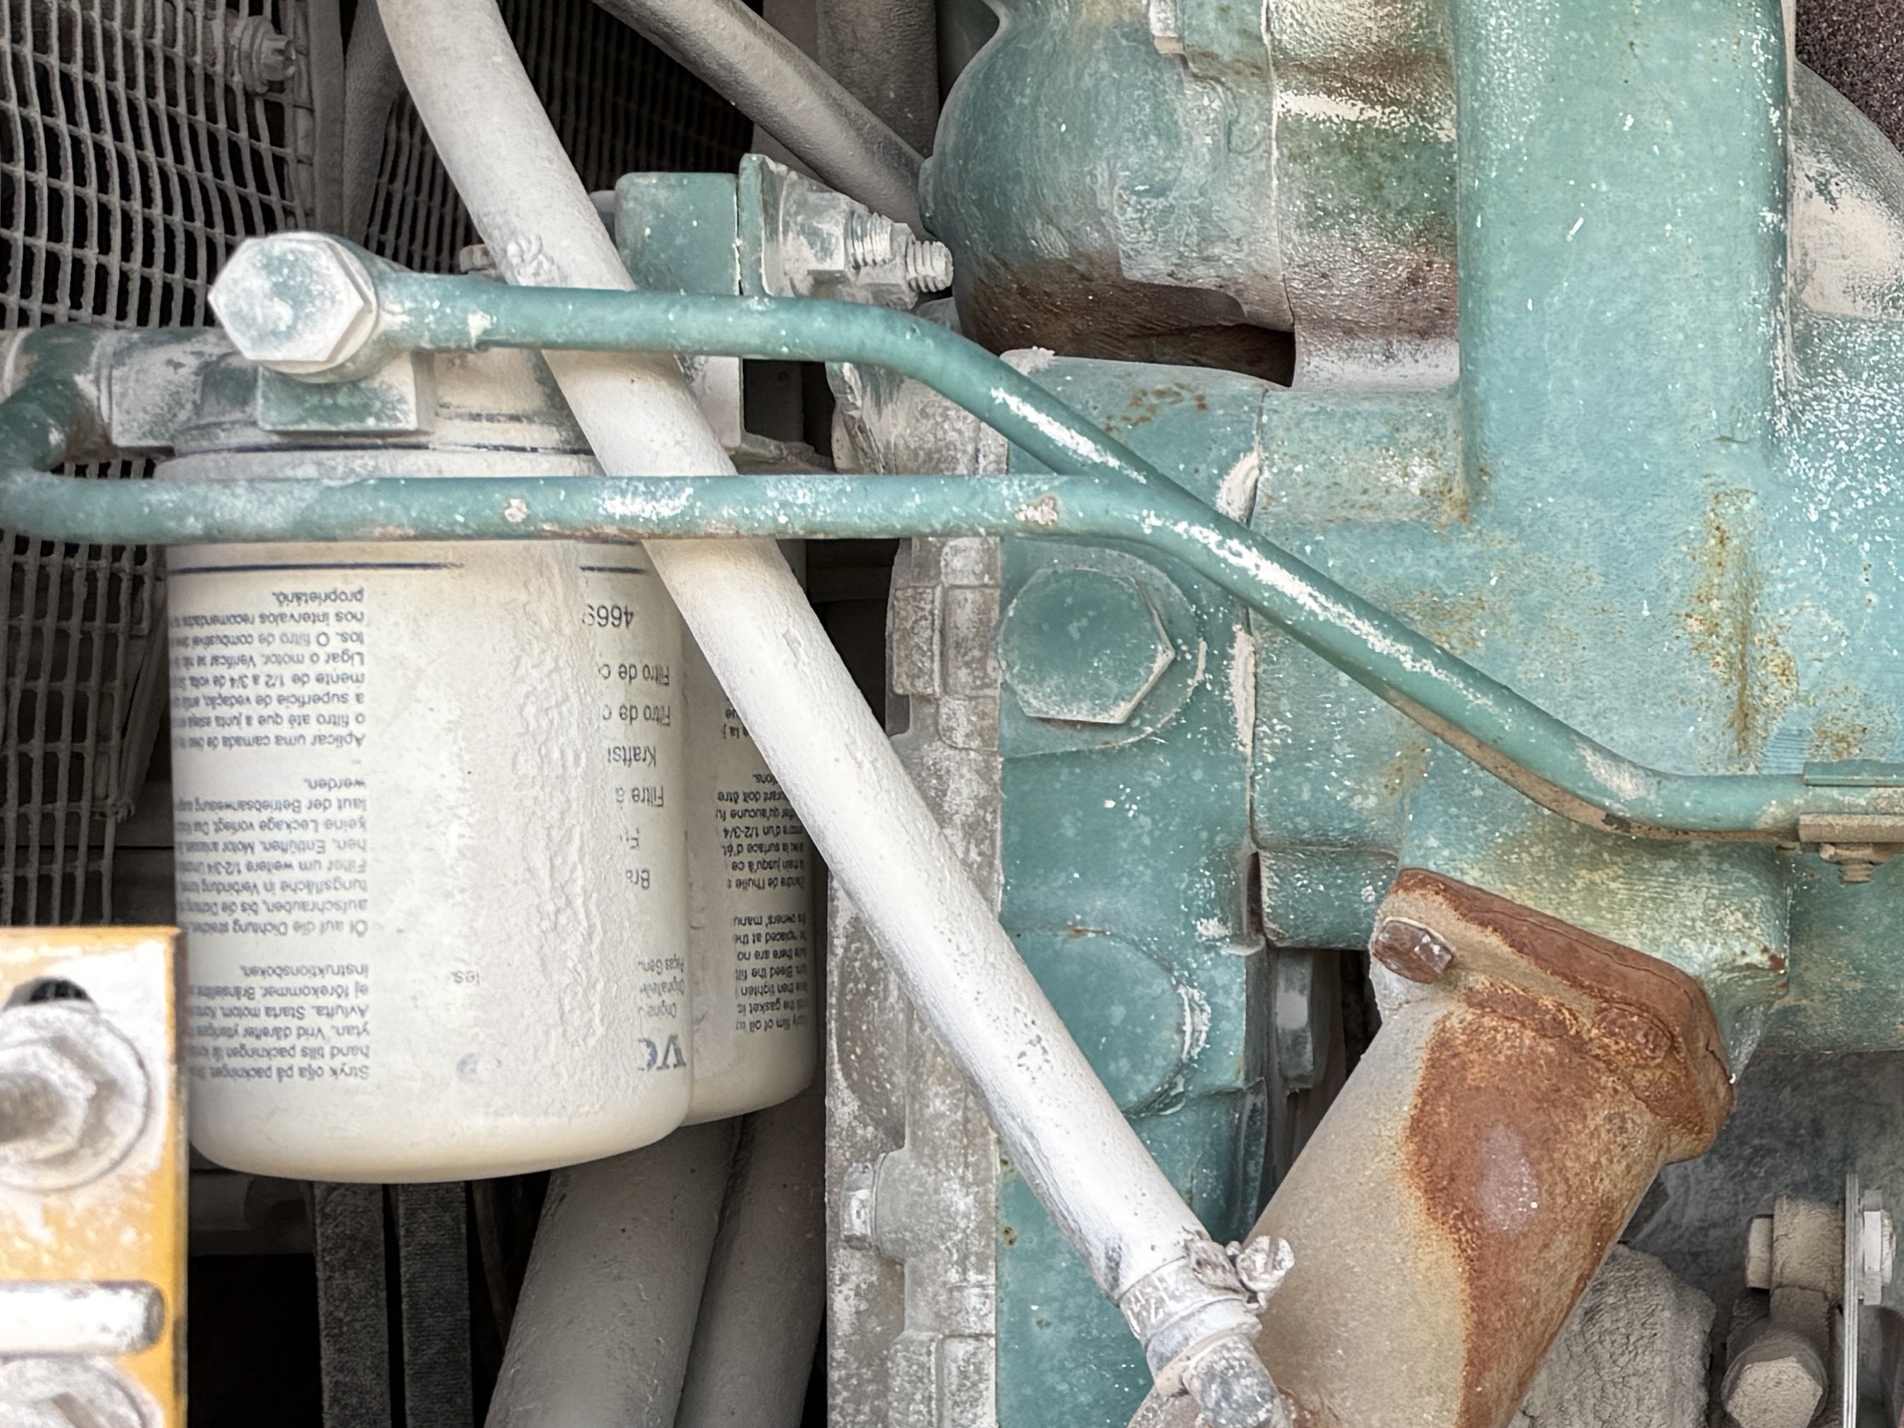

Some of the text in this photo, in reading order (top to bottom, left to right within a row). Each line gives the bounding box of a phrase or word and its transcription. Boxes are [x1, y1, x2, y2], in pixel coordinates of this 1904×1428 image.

[259, 612, 330, 626] intervalos
[336, 611, 364, 624] nos
[258, 634, 274, 647] de
[279, 632, 310, 647] filtro
[316, 632, 329, 646] O
[310, 652, 320, 665] o
[325, 649, 364, 665] Ligar
[230, 674, 248, 689] 3/4
[252, 674, 260, 685] a
[265, 674, 285, 687] 1/2
[291, 674, 310, 687] de
[316, 673, 364, 685] mente
[618, 663, 637, 686] de
[255, 694, 272, 708] de
[356, 693, 364, 704] a
[246, 715, 253, 727] a
[258, 711, 283, 726] que
[288, 714, 310, 728] até
[316, 713, 349, 727] filtro
[356, 713, 365, 724] o
[207, 737, 219, 749] de
[221, 736, 270, 749] camada
[275, 734, 306, 747] uma
[311, 732, 365, 748] Aplicar
[631, 785, 664, 808] Filtre
[718, 792, 739, 804] être
[307, 798, 331, 812] der
[336, 798, 366, 812] laut
[260, 817, 318, 834] Leckage
[723, 826, 759, 839] 1/2-3/4
[222, 842, 254, 855] Motor
[246, 861, 293, 874] weitere
[299, 861, 321, 872] um
[327, 859, 366, 874] Filter
[732, 861, 744, 873] ce
[263, 881, 275, 894] in
[240, 901, 258, 916] bis
[232, 919, 288, 937] Dichtung
[293, 921, 315, 936] die
[320, 920, 344, 936] auf
[350, 920, 368, 938] Öl
[752, 933, 761, 944] at
[755, 950, 770, 960] are
[752, 968, 767, 978] the
[265, 1006, 305, 1020] Starta
[749, 998, 780, 1014] gasket
[301, 1046, 324, 1060] tills
[330, 1044, 370, 1060] hand
[276, 1065, 294, 1083] på
[299, 1063, 324, 1081] olja
[329, 1062, 370, 1080] Stryk
